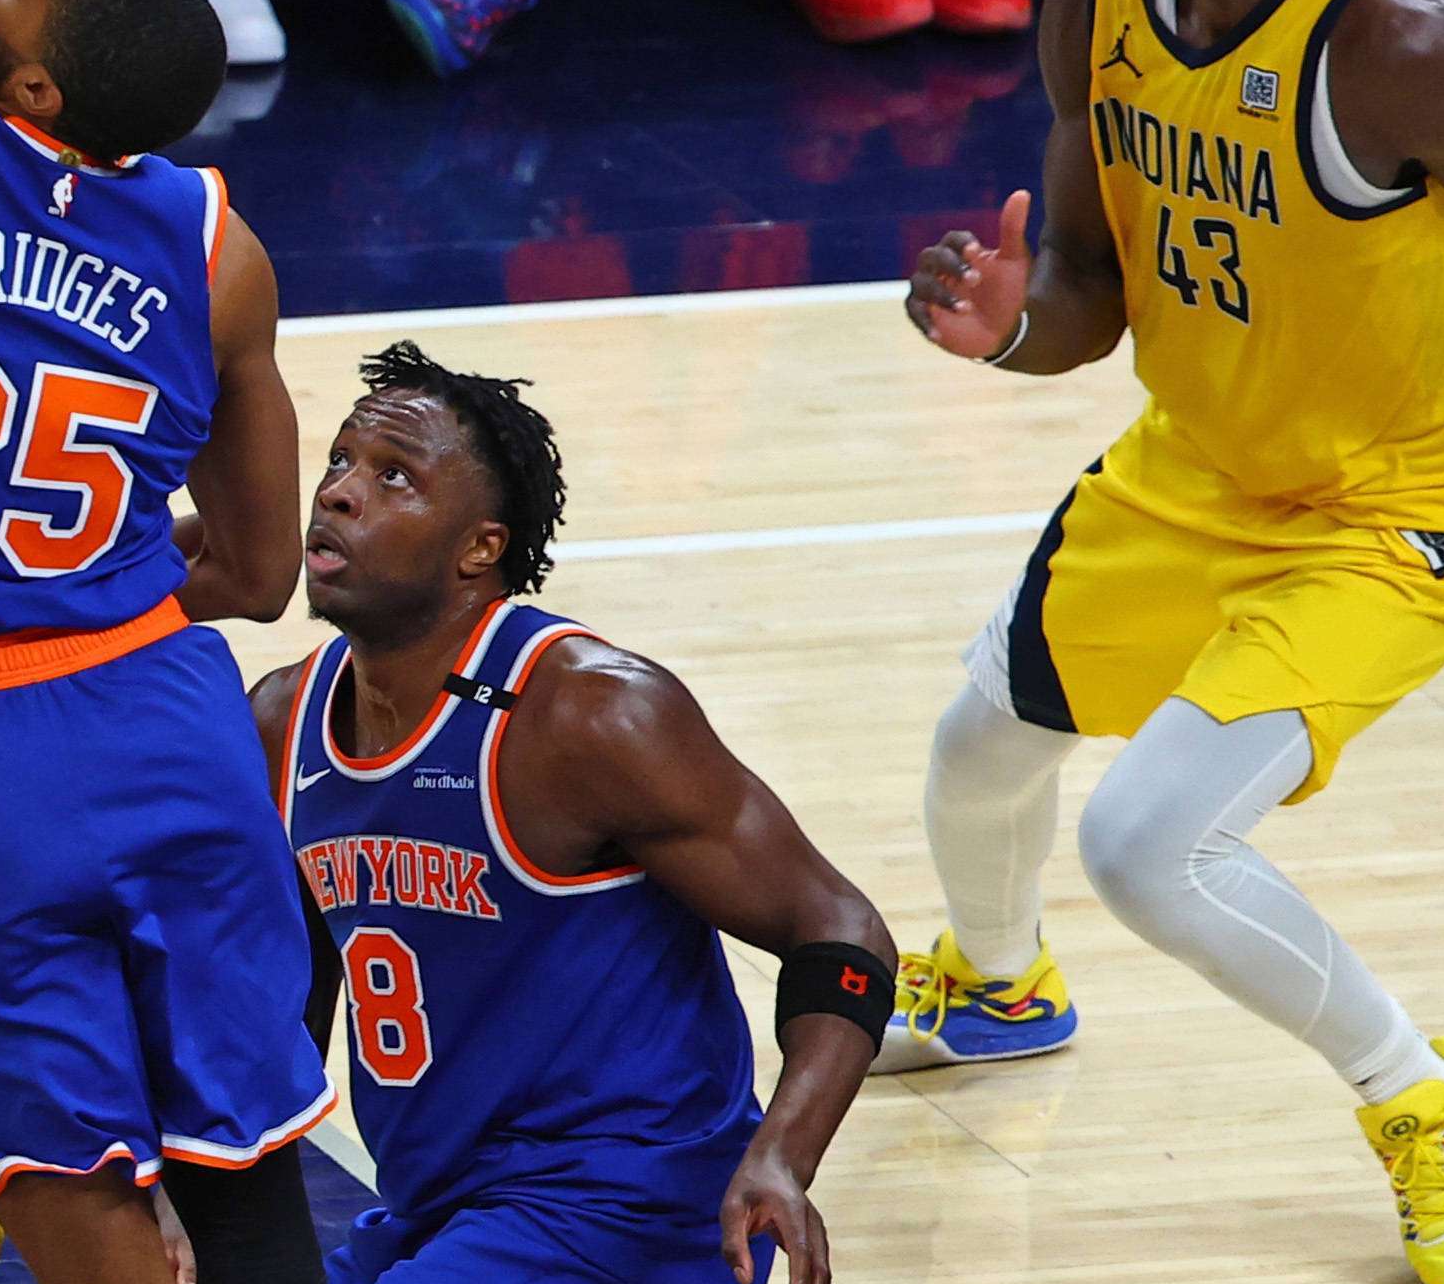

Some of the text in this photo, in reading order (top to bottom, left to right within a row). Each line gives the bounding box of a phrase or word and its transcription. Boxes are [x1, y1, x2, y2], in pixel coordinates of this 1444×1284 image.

[1092, 96, 1282, 227] INDIANA
[1157, 202, 1252, 326] 43
[473, 684, 493, 705] 12
[437, 775, 475, 790] dhabi
[359, 835, 503, 922] YORK
[341, 926, 433, 1087] 8
